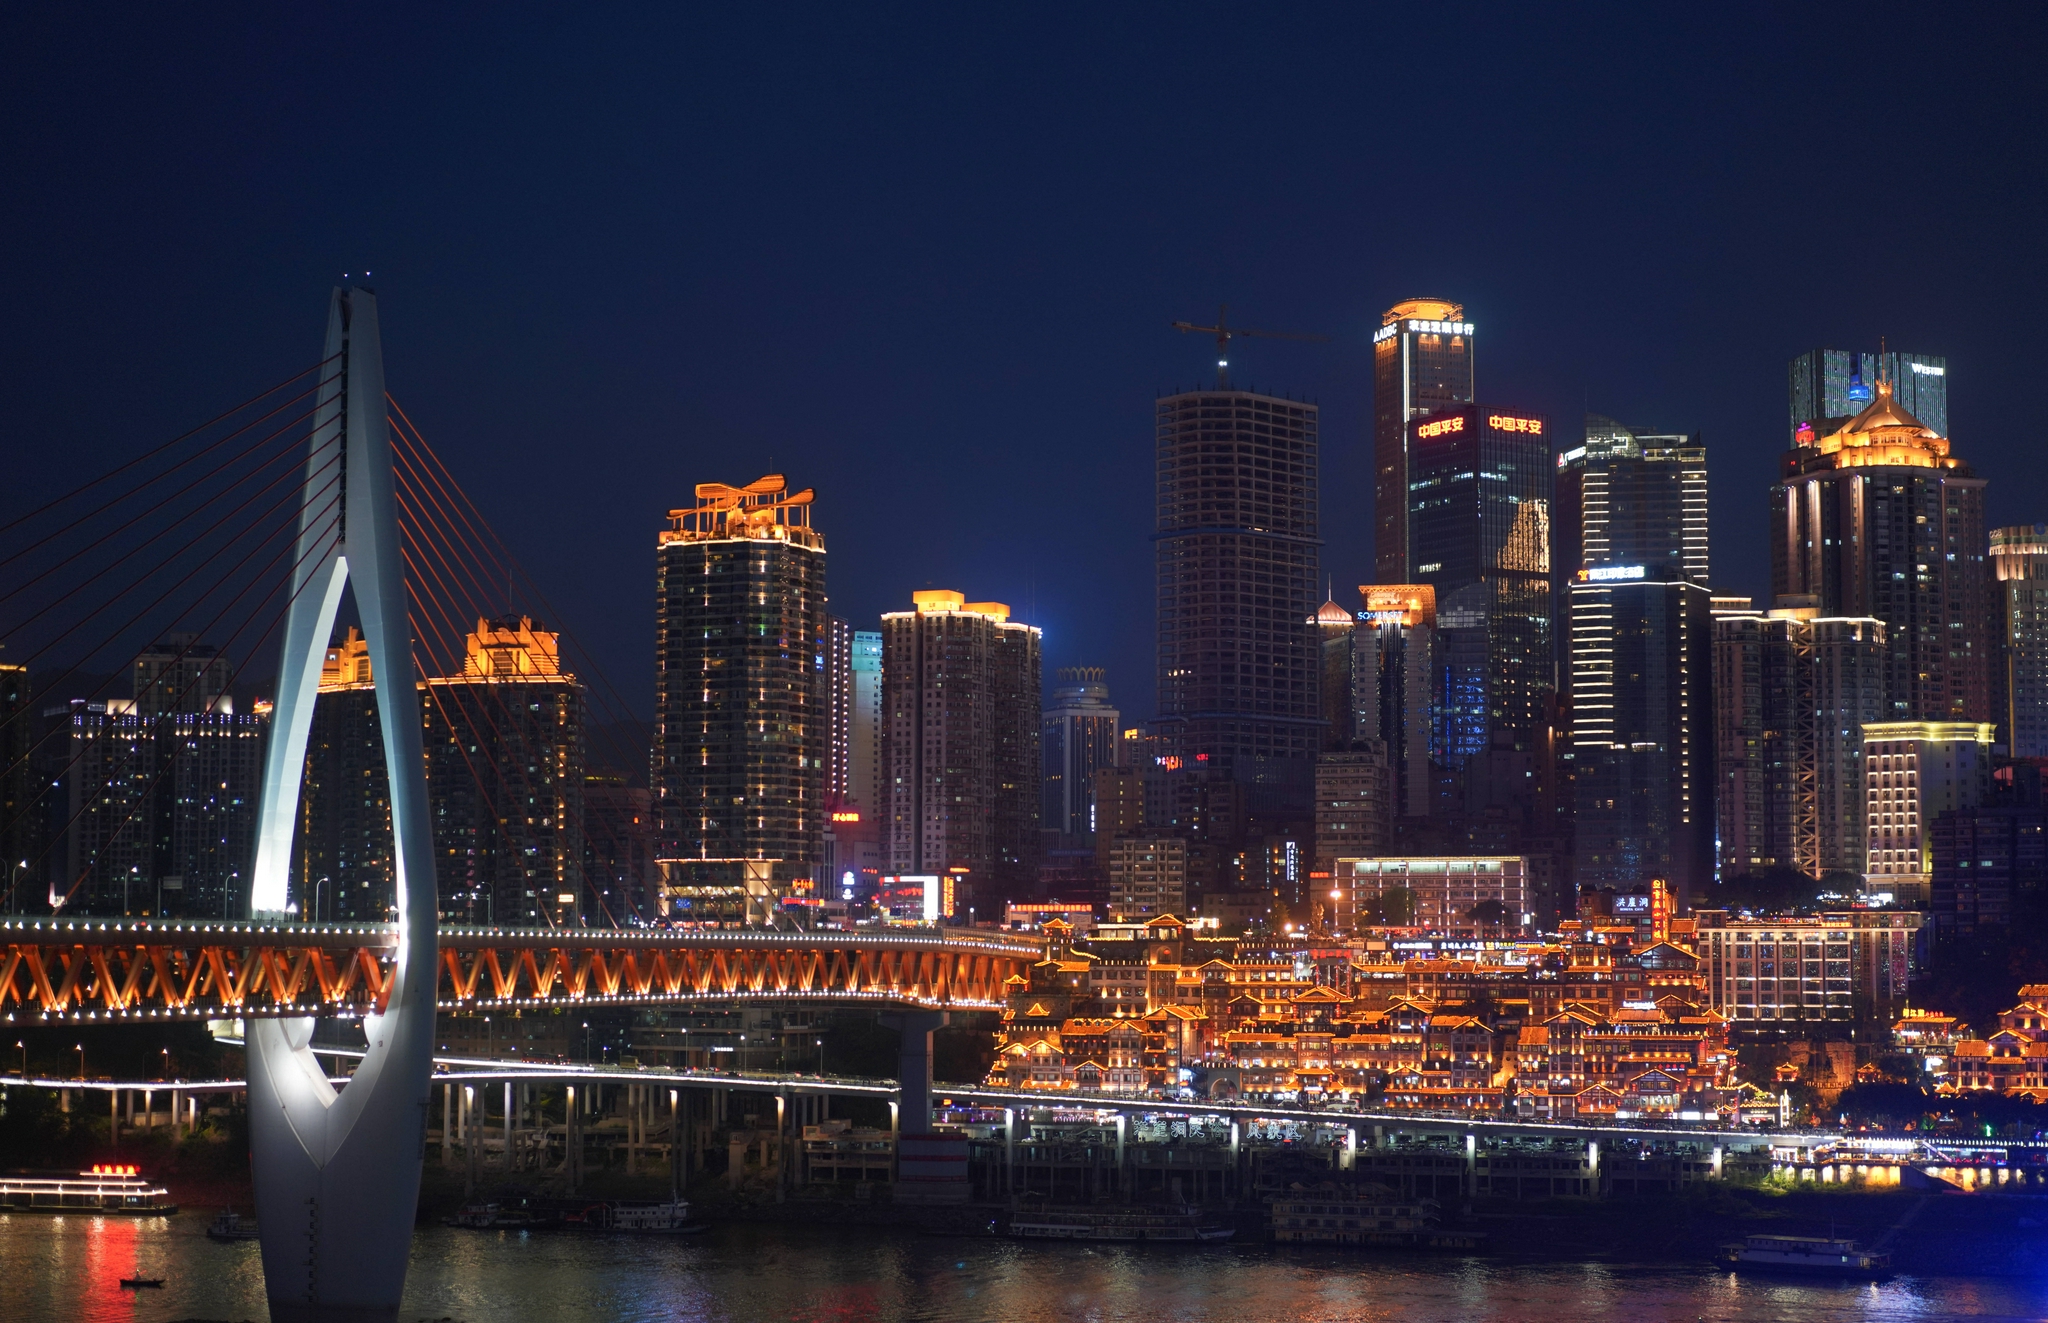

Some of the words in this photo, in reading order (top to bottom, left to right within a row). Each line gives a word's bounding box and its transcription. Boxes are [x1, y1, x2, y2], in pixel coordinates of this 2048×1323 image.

[1418, 417, 1463, 438] 中国平安
[1489, 415, 1541, 434] 中国平安
[1357, 611, 1403, 621] SOMERSET
[1616, 897, 1649, 908] 洪崖洞
